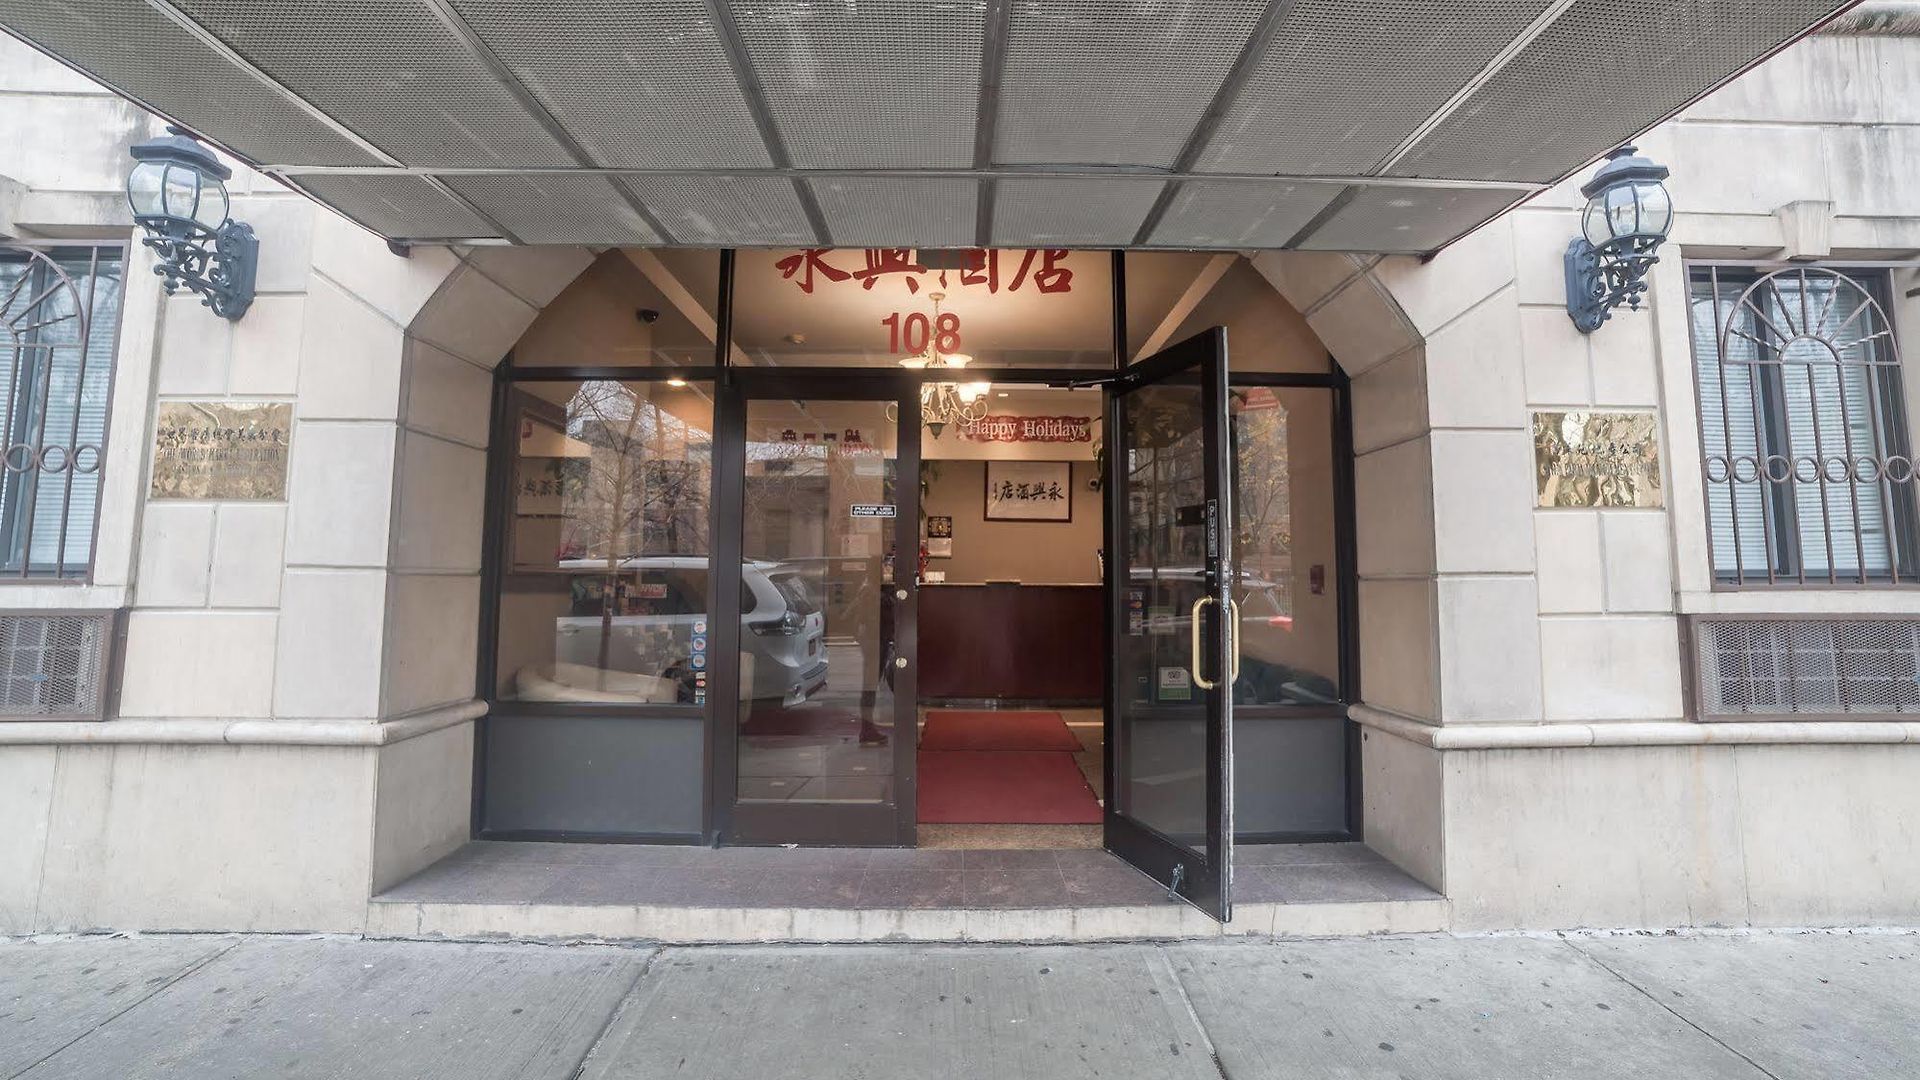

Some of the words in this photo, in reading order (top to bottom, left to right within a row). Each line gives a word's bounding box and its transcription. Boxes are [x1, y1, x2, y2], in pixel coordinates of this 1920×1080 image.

[882, 312, 961, 355] 108
[969, 420, 1017, 439] Happy
[1023, 419, 1086, 441] Holidays
